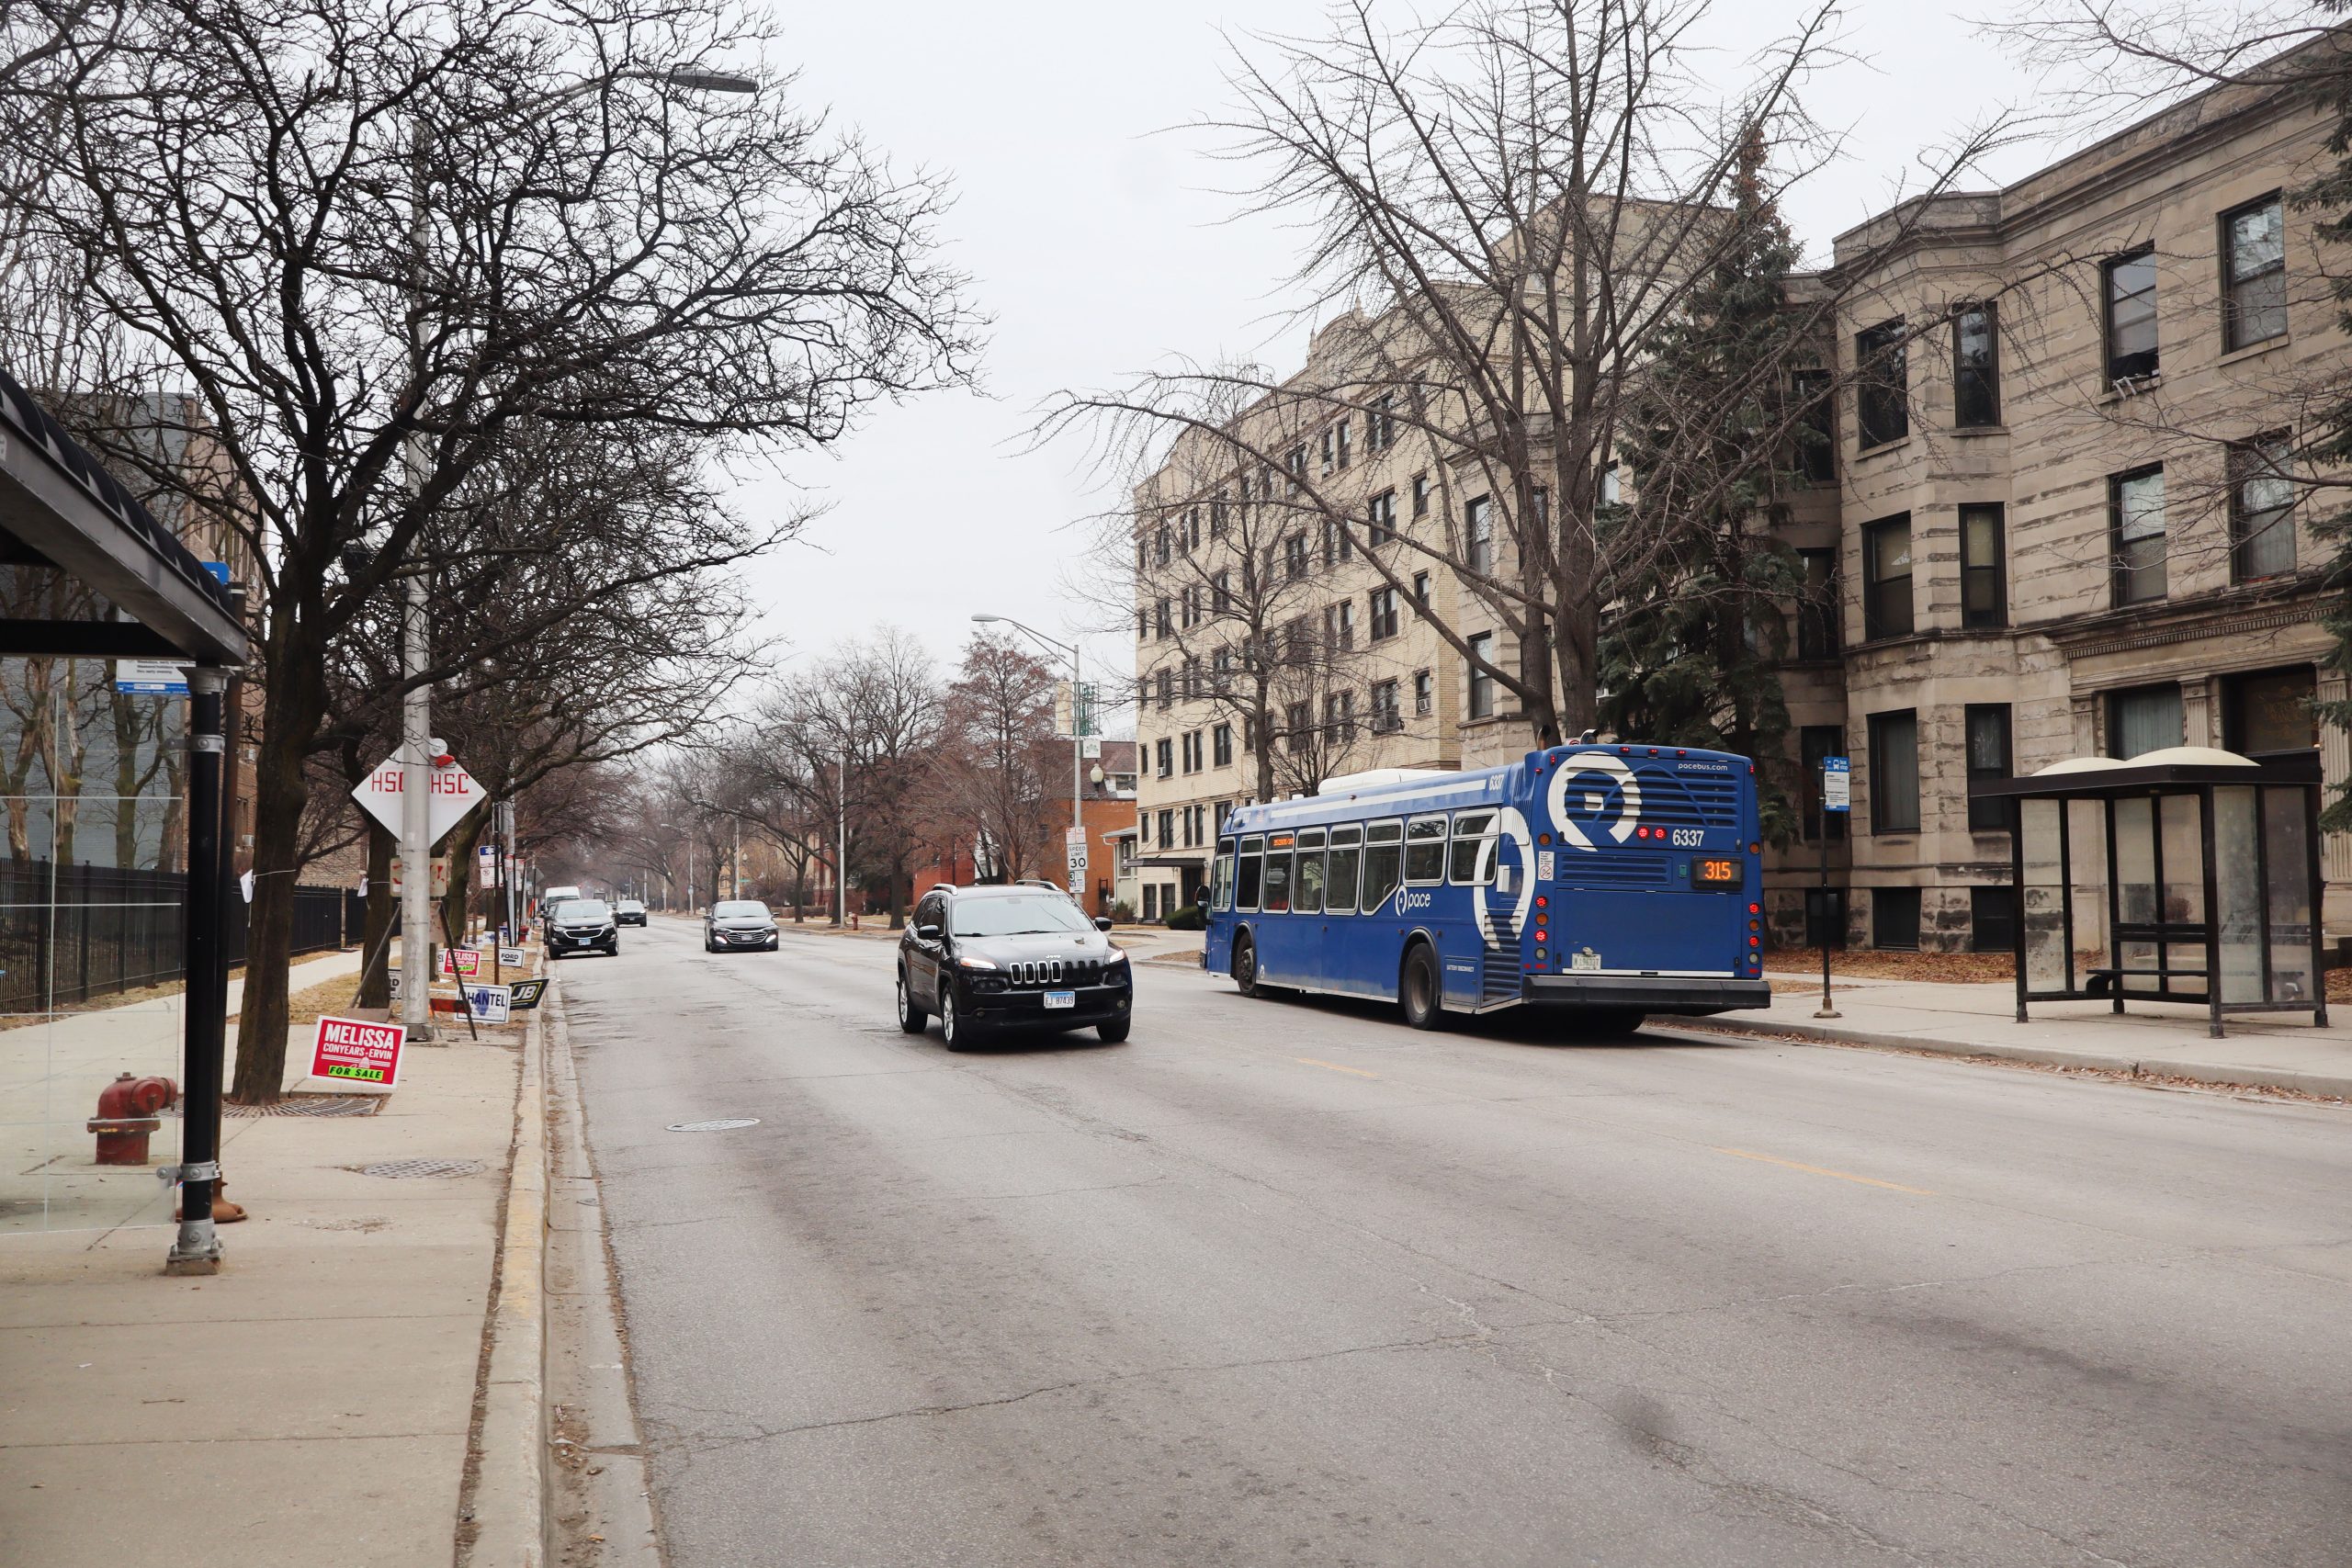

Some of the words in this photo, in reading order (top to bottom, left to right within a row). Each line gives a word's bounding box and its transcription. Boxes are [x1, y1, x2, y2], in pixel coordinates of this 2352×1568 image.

[1678, 763, 1728, 772] pacebus.com
[431, 773, 469, 794] HSC
[1489, 774, 1505, 791] 6337
[1672, 829, 1704, 846] 6337
[1069, 857, 1086, 868] 30
[1704, 862, 1731, 880] 315
[1408, 893, 1431, 910] pace
[467, 992, 505, 1007] HANTEL
[512, 986, 537, 1001] JB
[324, 1023, 394, 1050] MELISSA
[329, 1066, 351, 1077] FOR
[355, 1068, 382, 1079] SALE
